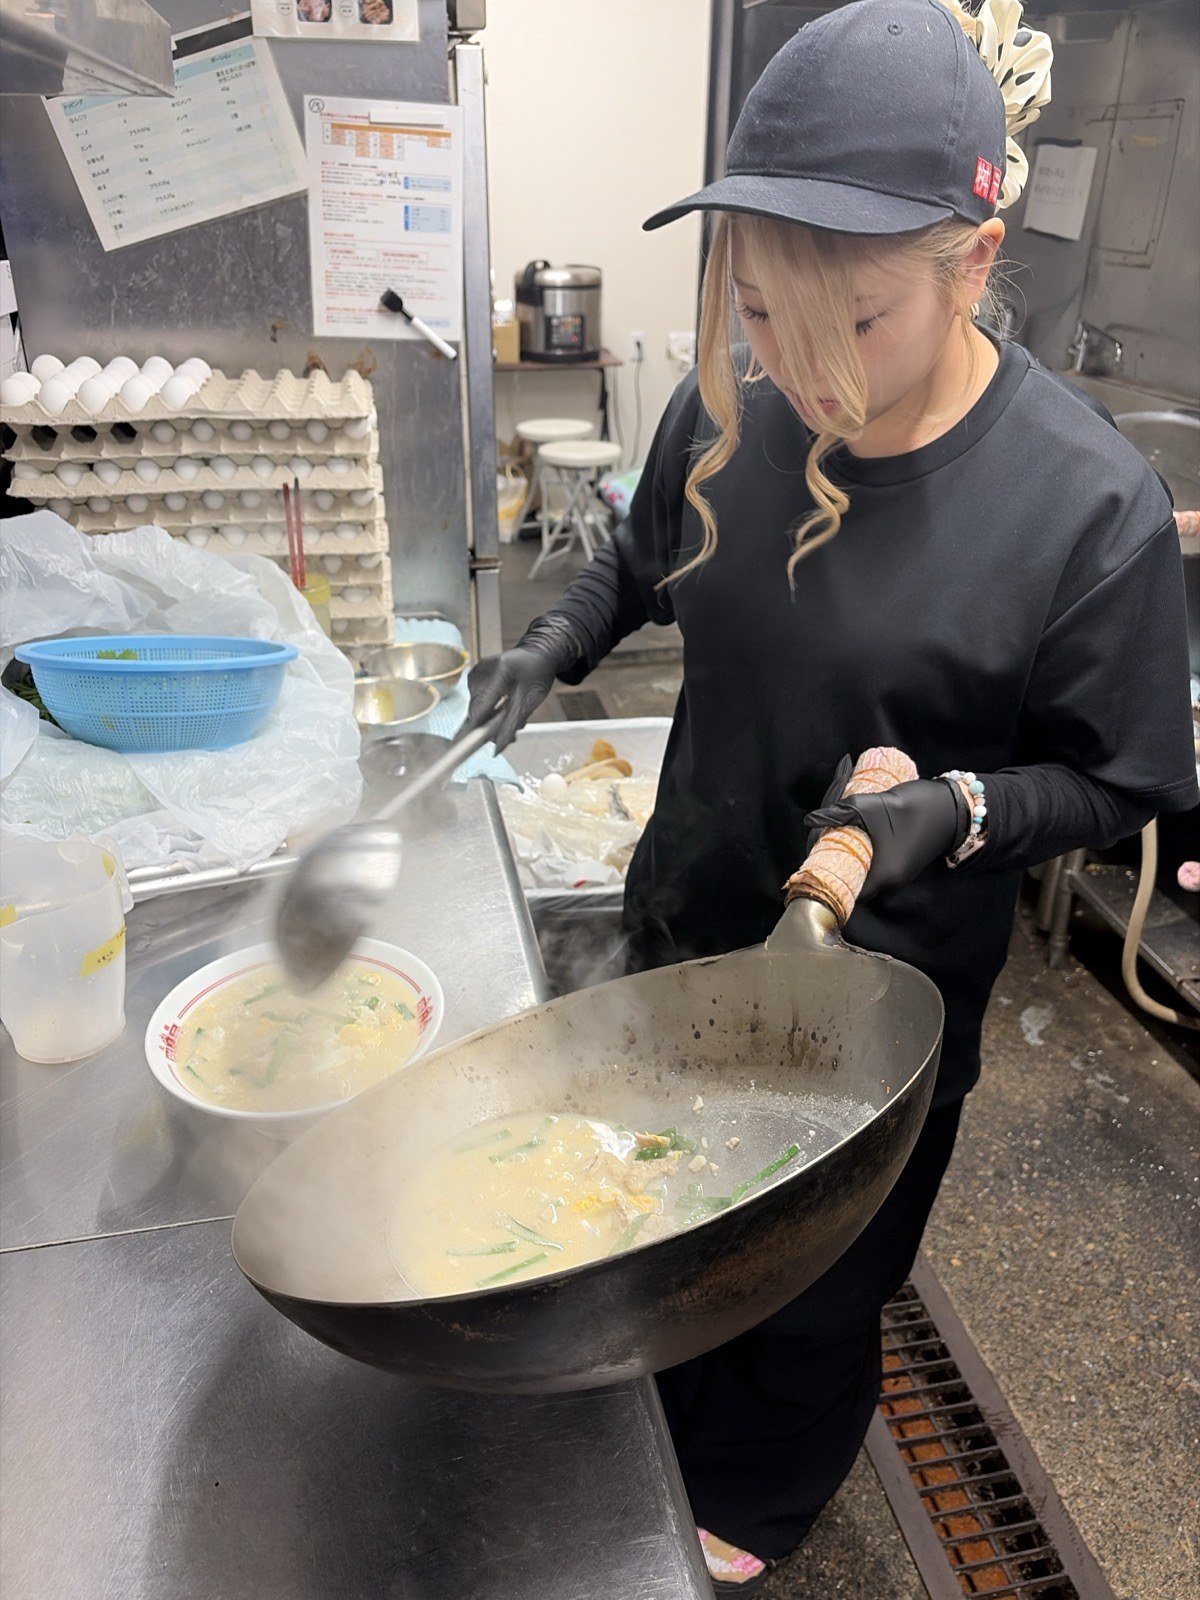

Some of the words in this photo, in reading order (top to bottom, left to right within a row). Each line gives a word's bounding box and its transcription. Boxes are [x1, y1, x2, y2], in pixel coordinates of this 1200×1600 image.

[63, 99, 83, 109] トッピング
